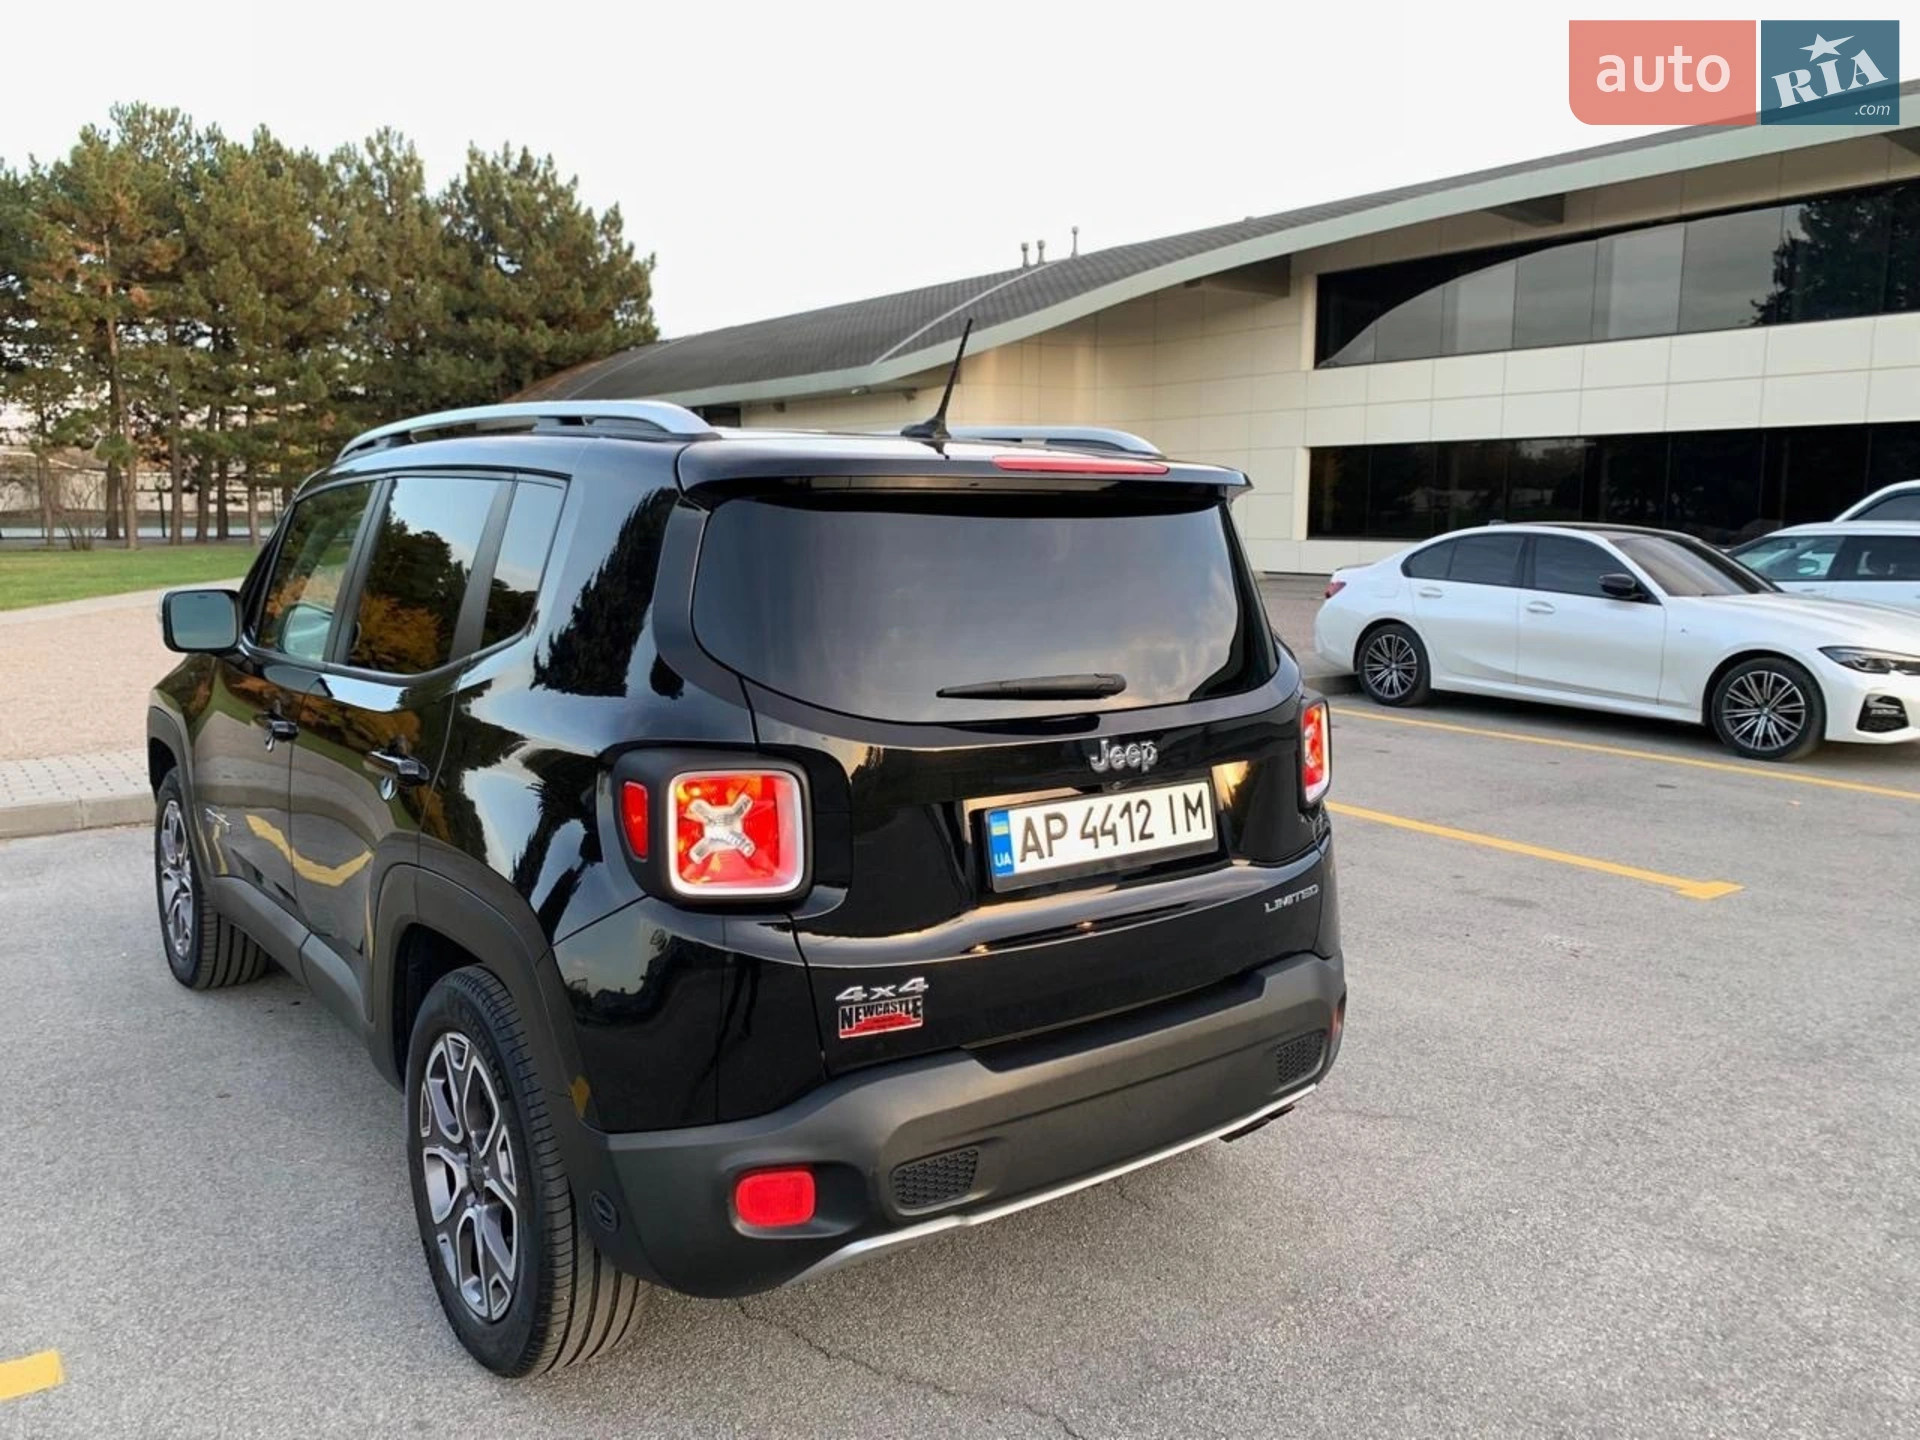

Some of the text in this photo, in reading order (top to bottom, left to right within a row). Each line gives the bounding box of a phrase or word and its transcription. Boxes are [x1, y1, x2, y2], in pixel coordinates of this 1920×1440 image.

[1090, 739, 1158, 772] Jeep
[1020, 790, 1207, 863] AP 4412 IM
[994, 852, 1012, 867] UA
[1264, 884, 1319, 913] LIMITED
[840, 998, 922, 1031] NEWCASTLE
